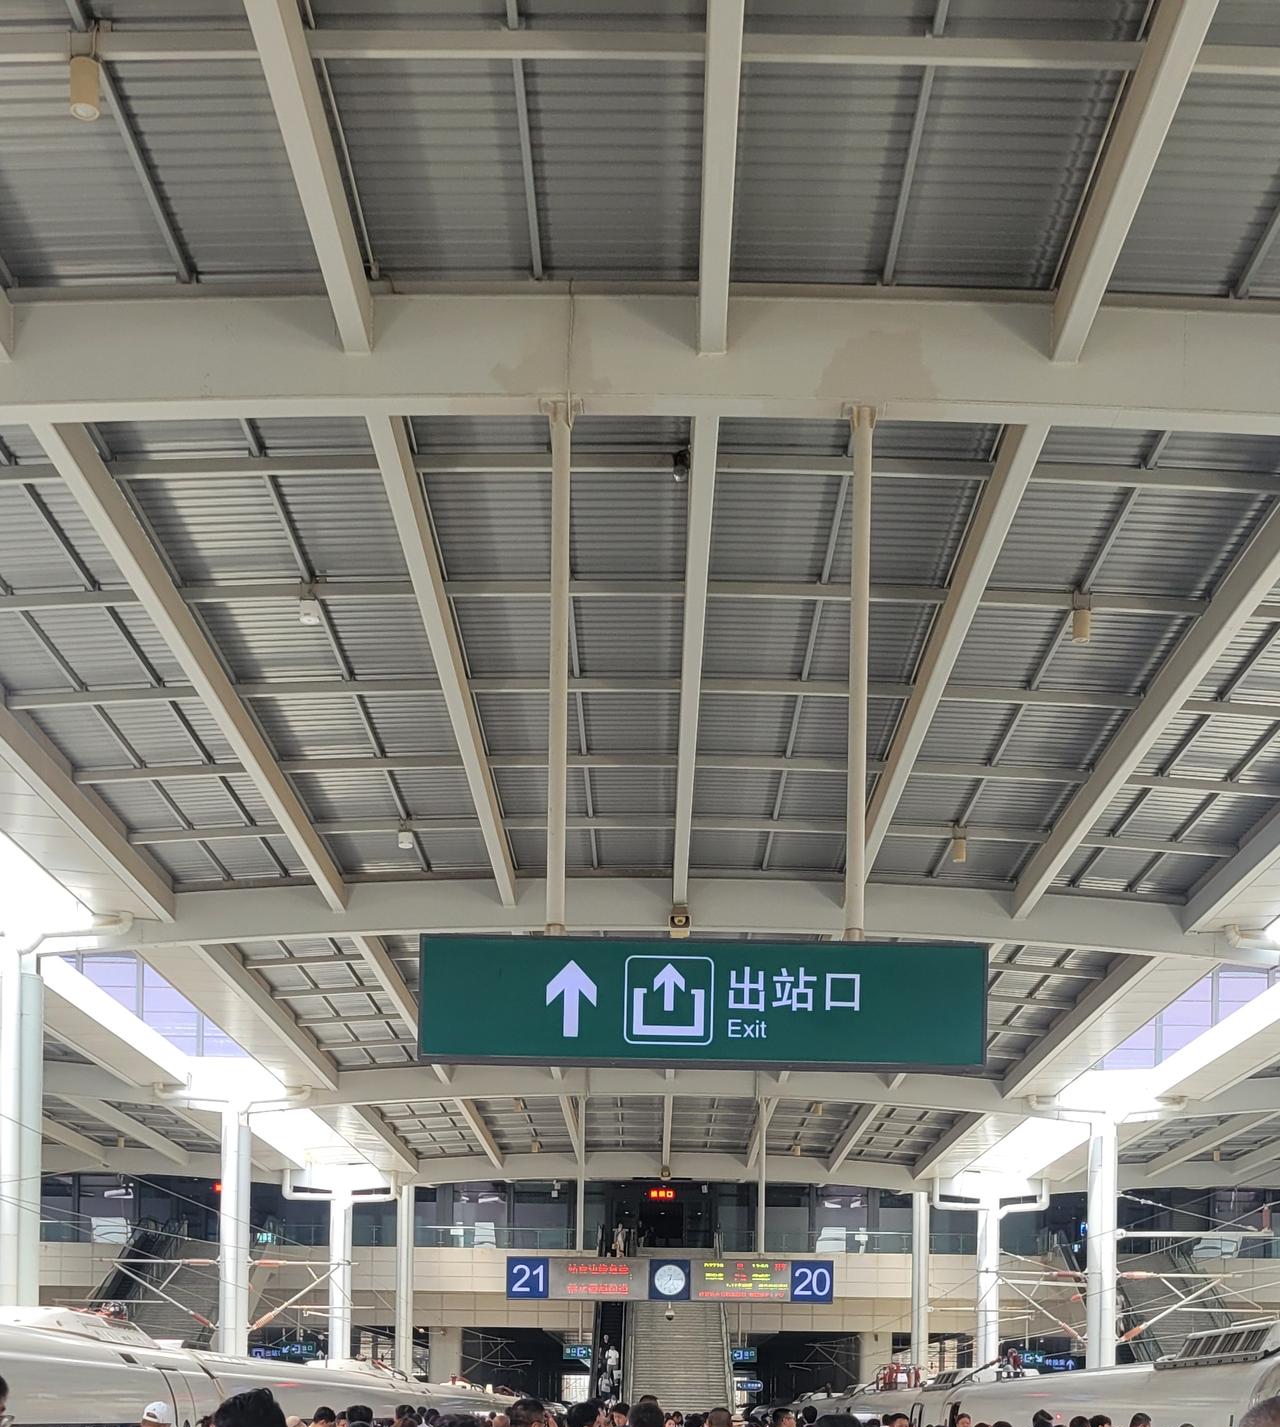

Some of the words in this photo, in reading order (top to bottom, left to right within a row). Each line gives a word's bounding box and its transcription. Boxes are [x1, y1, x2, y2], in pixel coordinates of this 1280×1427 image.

[728, 966, 861, 1012] 出站口
[727, 1018, 767, 1039] Exit
[511, 1264, 544, 1292] 21
[793, 1267, 831, 1296] 20
